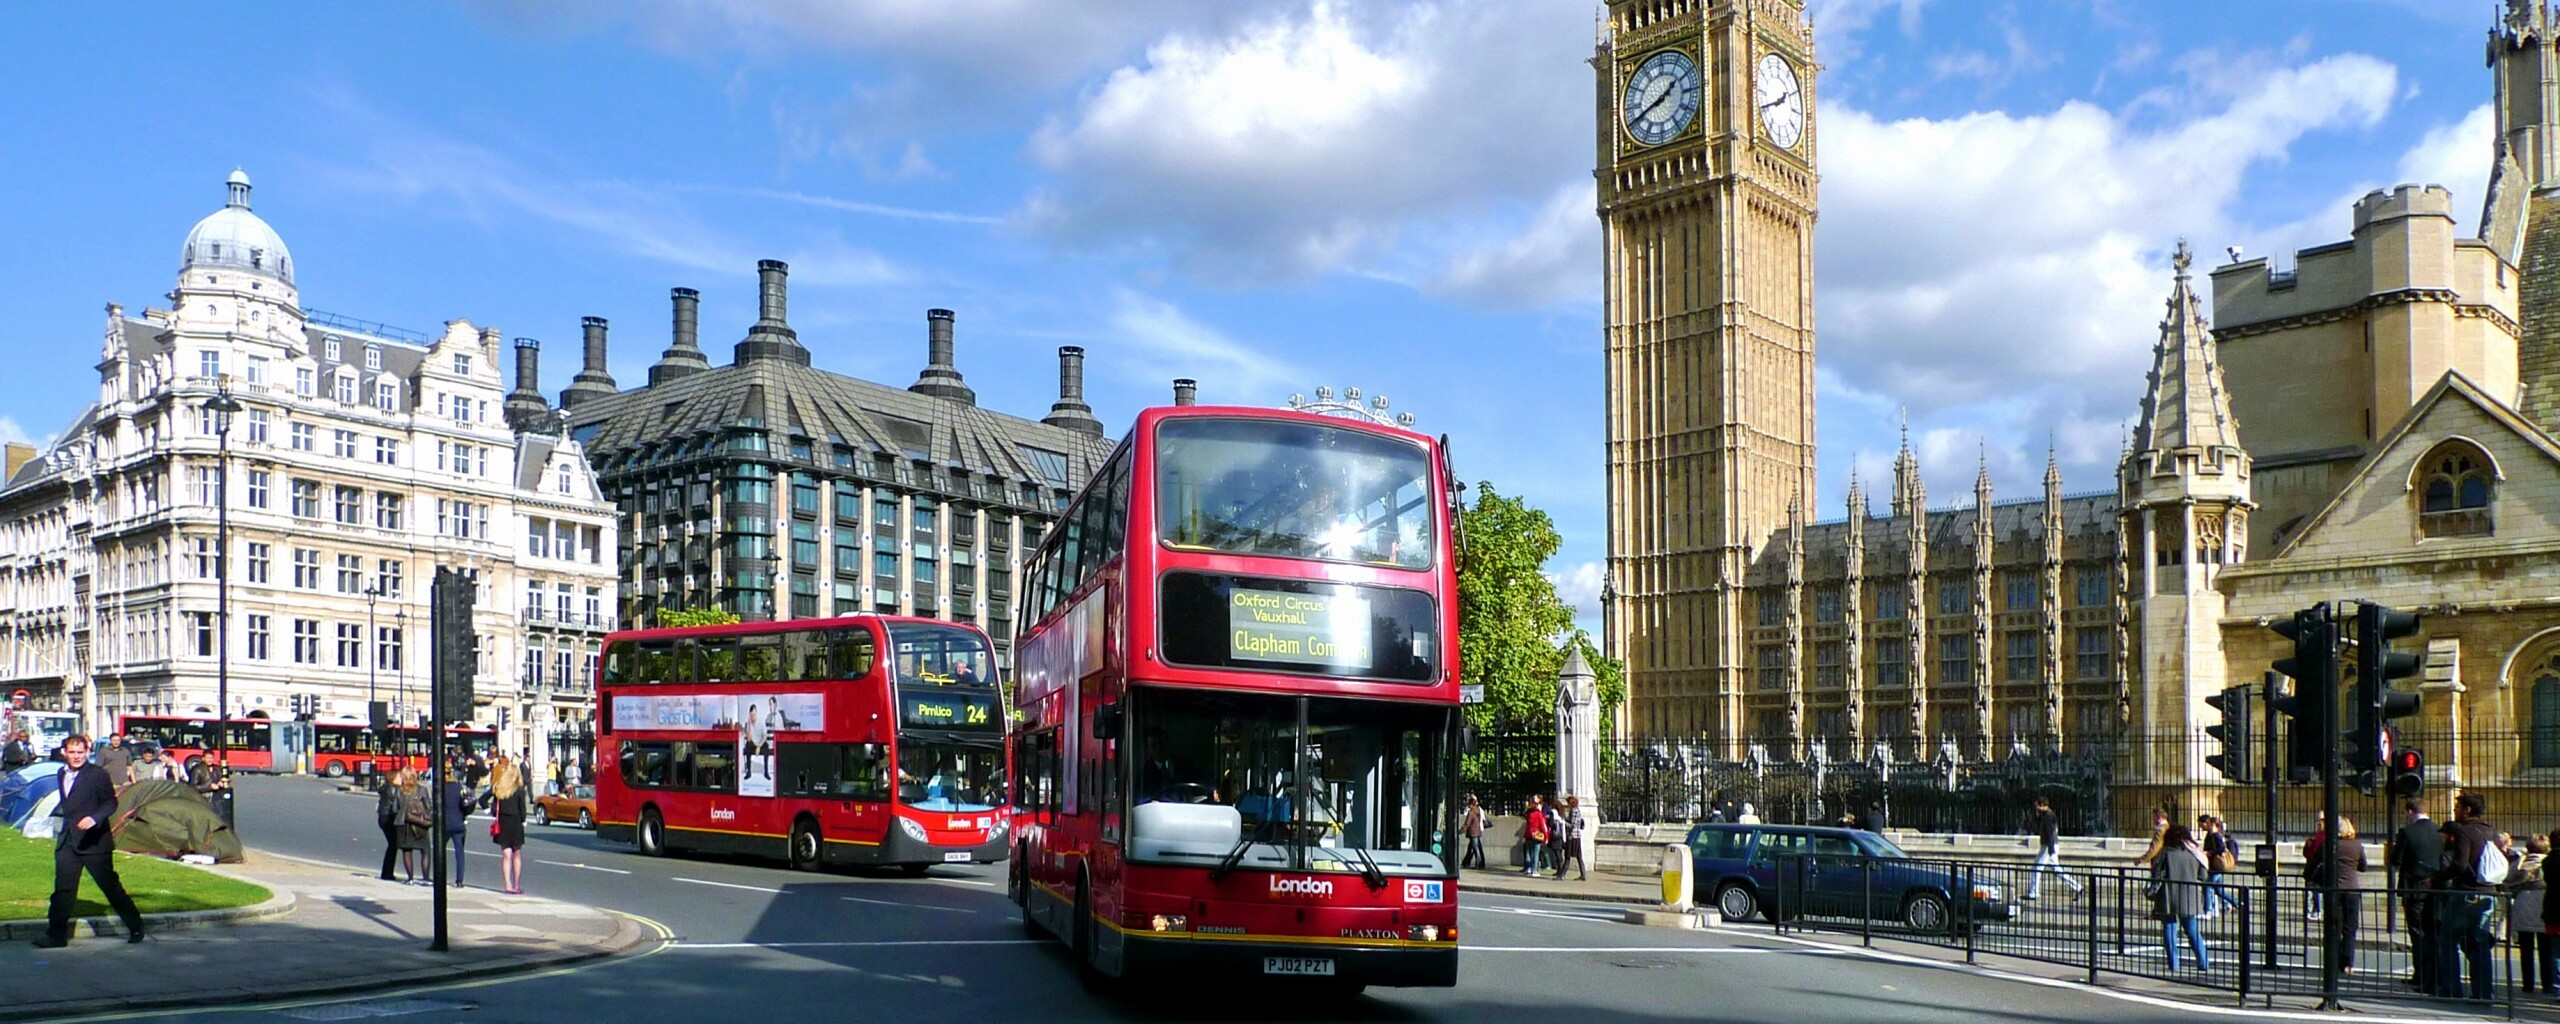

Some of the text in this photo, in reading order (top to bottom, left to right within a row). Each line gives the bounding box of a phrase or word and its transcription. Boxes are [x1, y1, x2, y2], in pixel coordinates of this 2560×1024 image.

[1234, 593, 1325, 612] Oxford Circus
[1252, 609, 1307, 624] Vauxhall
[1234, 630, 1368, 659] Clapham Comn
[918, 704, 953, 717] Pimlico
[966, 705, 987, 724] 24
[710, 807, 735, 820] London
[948, 818, 972, 828] London
[1270, 874, 1333, 894] London
[1197, 925, 1246, 934] DENNIS
[1341, 928, 1400, 940] PLAXTON
[1268, 958, 1330, 973] PJ02 PZT
